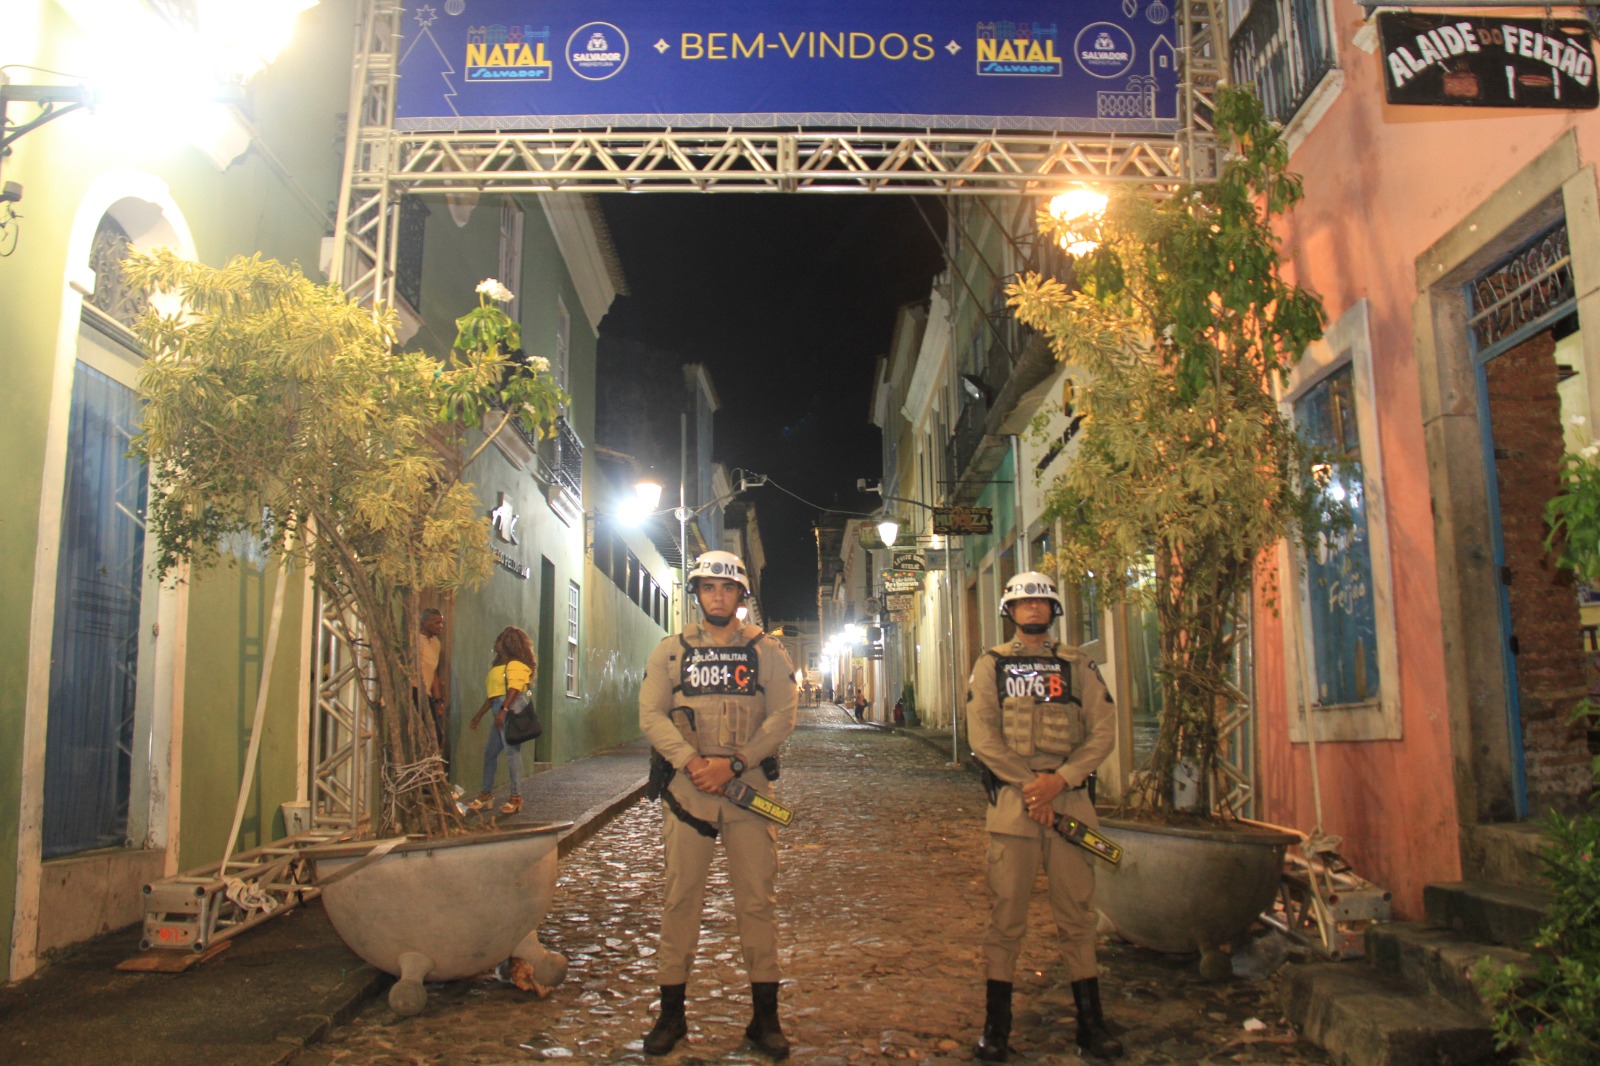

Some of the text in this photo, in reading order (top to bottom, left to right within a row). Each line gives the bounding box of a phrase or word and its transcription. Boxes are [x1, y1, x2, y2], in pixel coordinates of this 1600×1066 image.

[466, 43, 552, 66] NATAL
[680, 32, 935, 60] BEM-VINDOS
[976, 38, 1062, 62] NATAL
[1082, 51, 1129, 61] SALVADOR
[1387, 22, 1481, 88] ALAIDE
[1478, 28, 1504, 45] DO
[573, 53, 621, 62] SALVADOR
[719, 652, 748, 662] MILITAR
[1034, 662, 1061, 672] MILITAR
[734, 665, 748, 687] C
[1005, 675, 1063, 697] 0076 B
